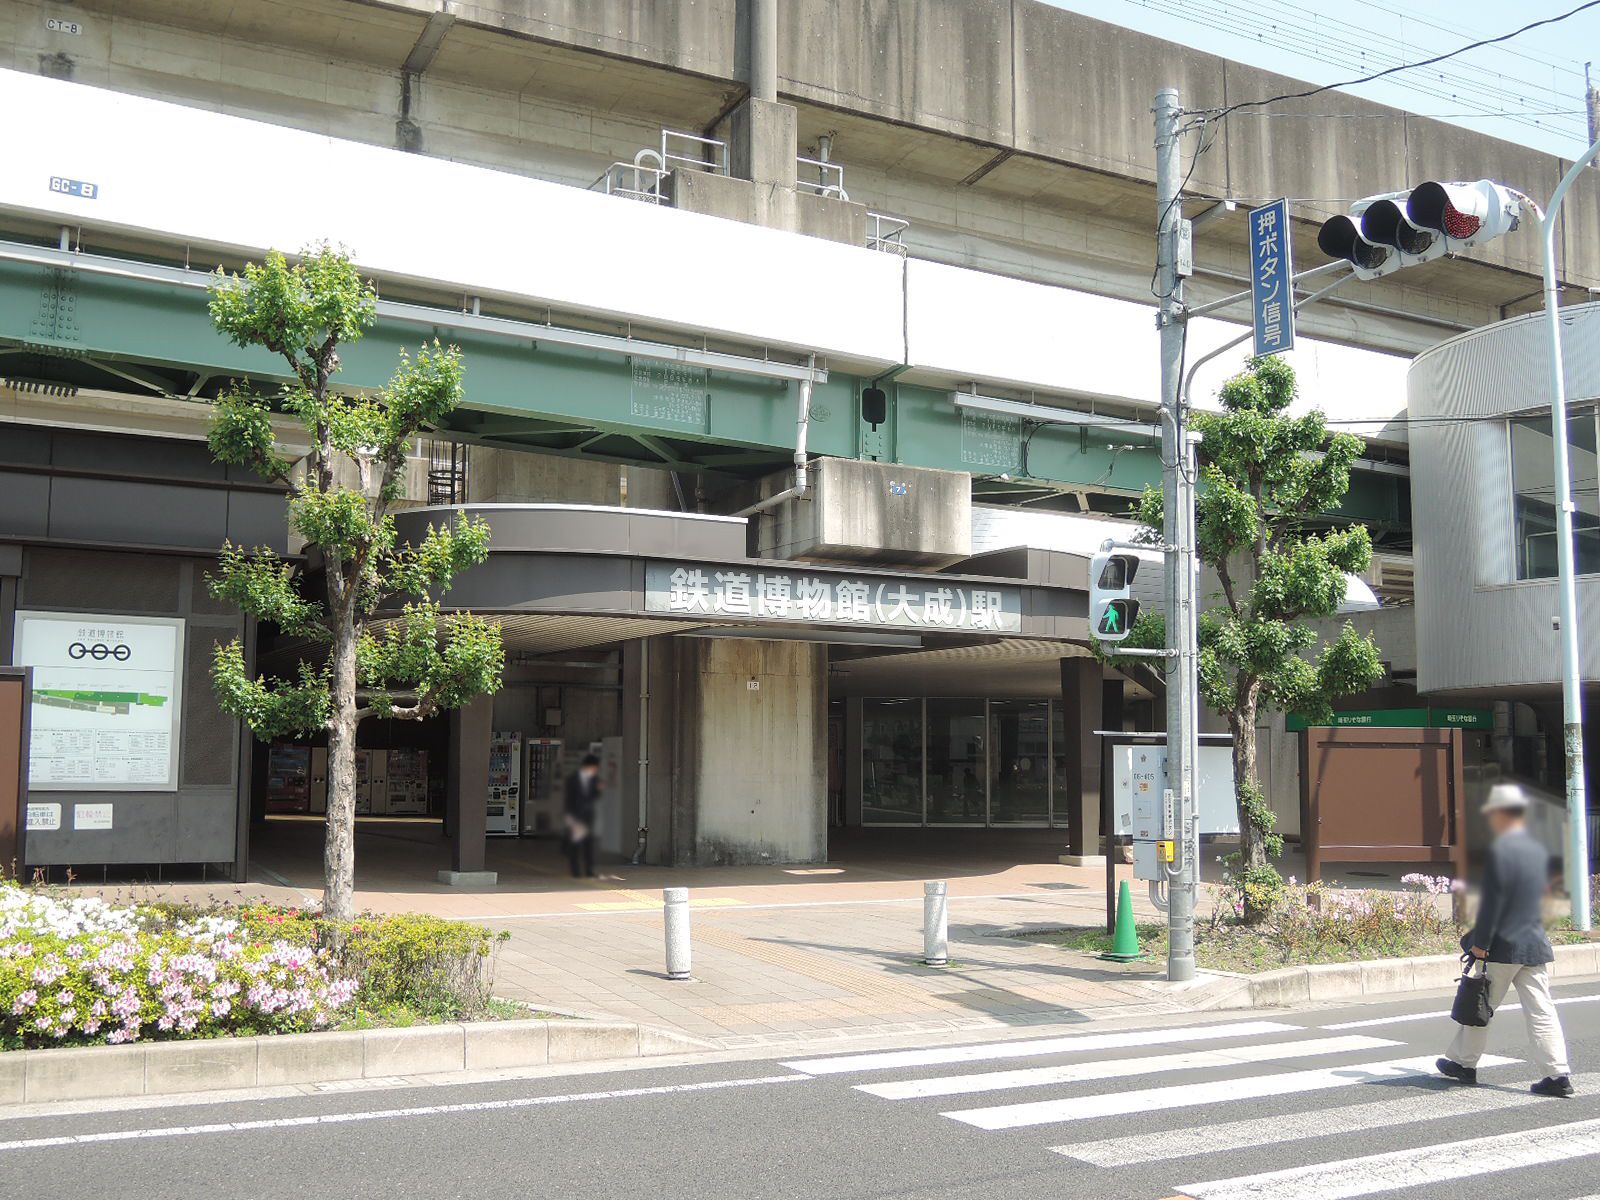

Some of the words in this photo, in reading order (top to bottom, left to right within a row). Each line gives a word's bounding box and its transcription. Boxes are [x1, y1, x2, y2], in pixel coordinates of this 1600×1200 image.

[47, 19, 78, 34] CT-8
[51, 177, 95, 197] GC-8
[1257, 210, 1283, 346] 押ボタン信号
[669, 567, 1004, 630] 鉄道博物館(大成)駅
